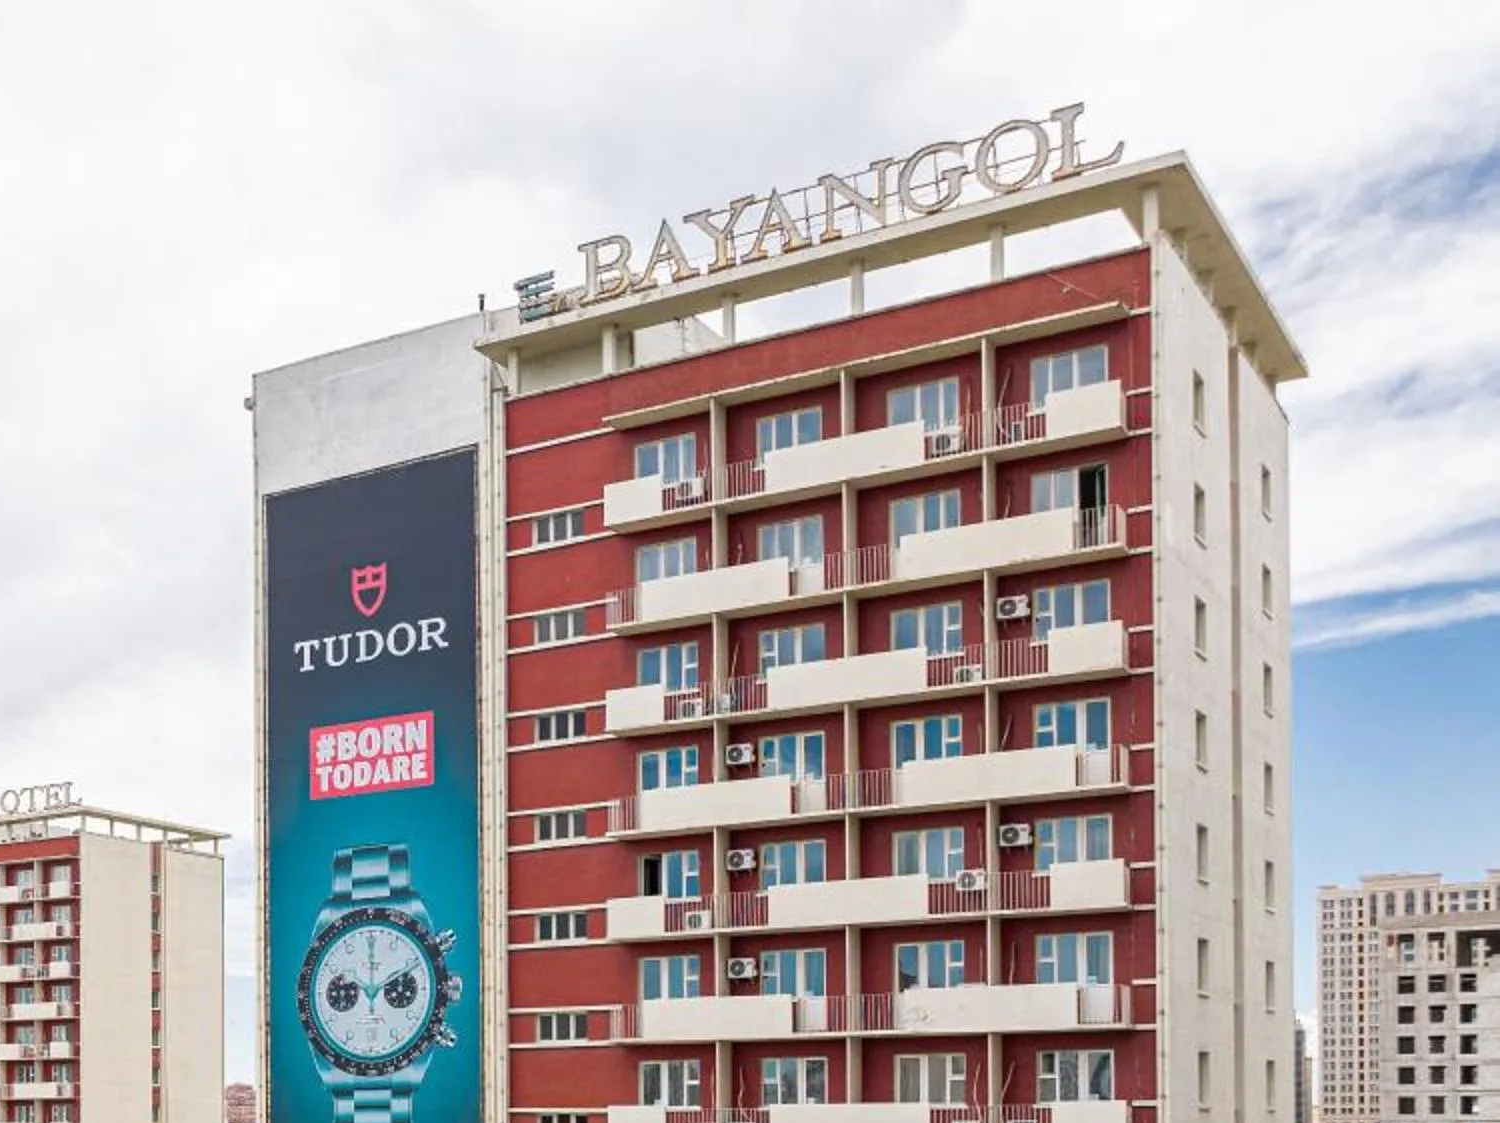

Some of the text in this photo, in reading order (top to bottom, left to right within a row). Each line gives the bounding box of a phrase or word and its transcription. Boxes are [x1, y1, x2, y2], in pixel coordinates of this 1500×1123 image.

[577, 102, 1125, 308] BAYANGOL
[294, 617, 449, 673] TUDOR
[315, 719, 428, 764] #BORN
[316, 752, 428, 792] TODARE
